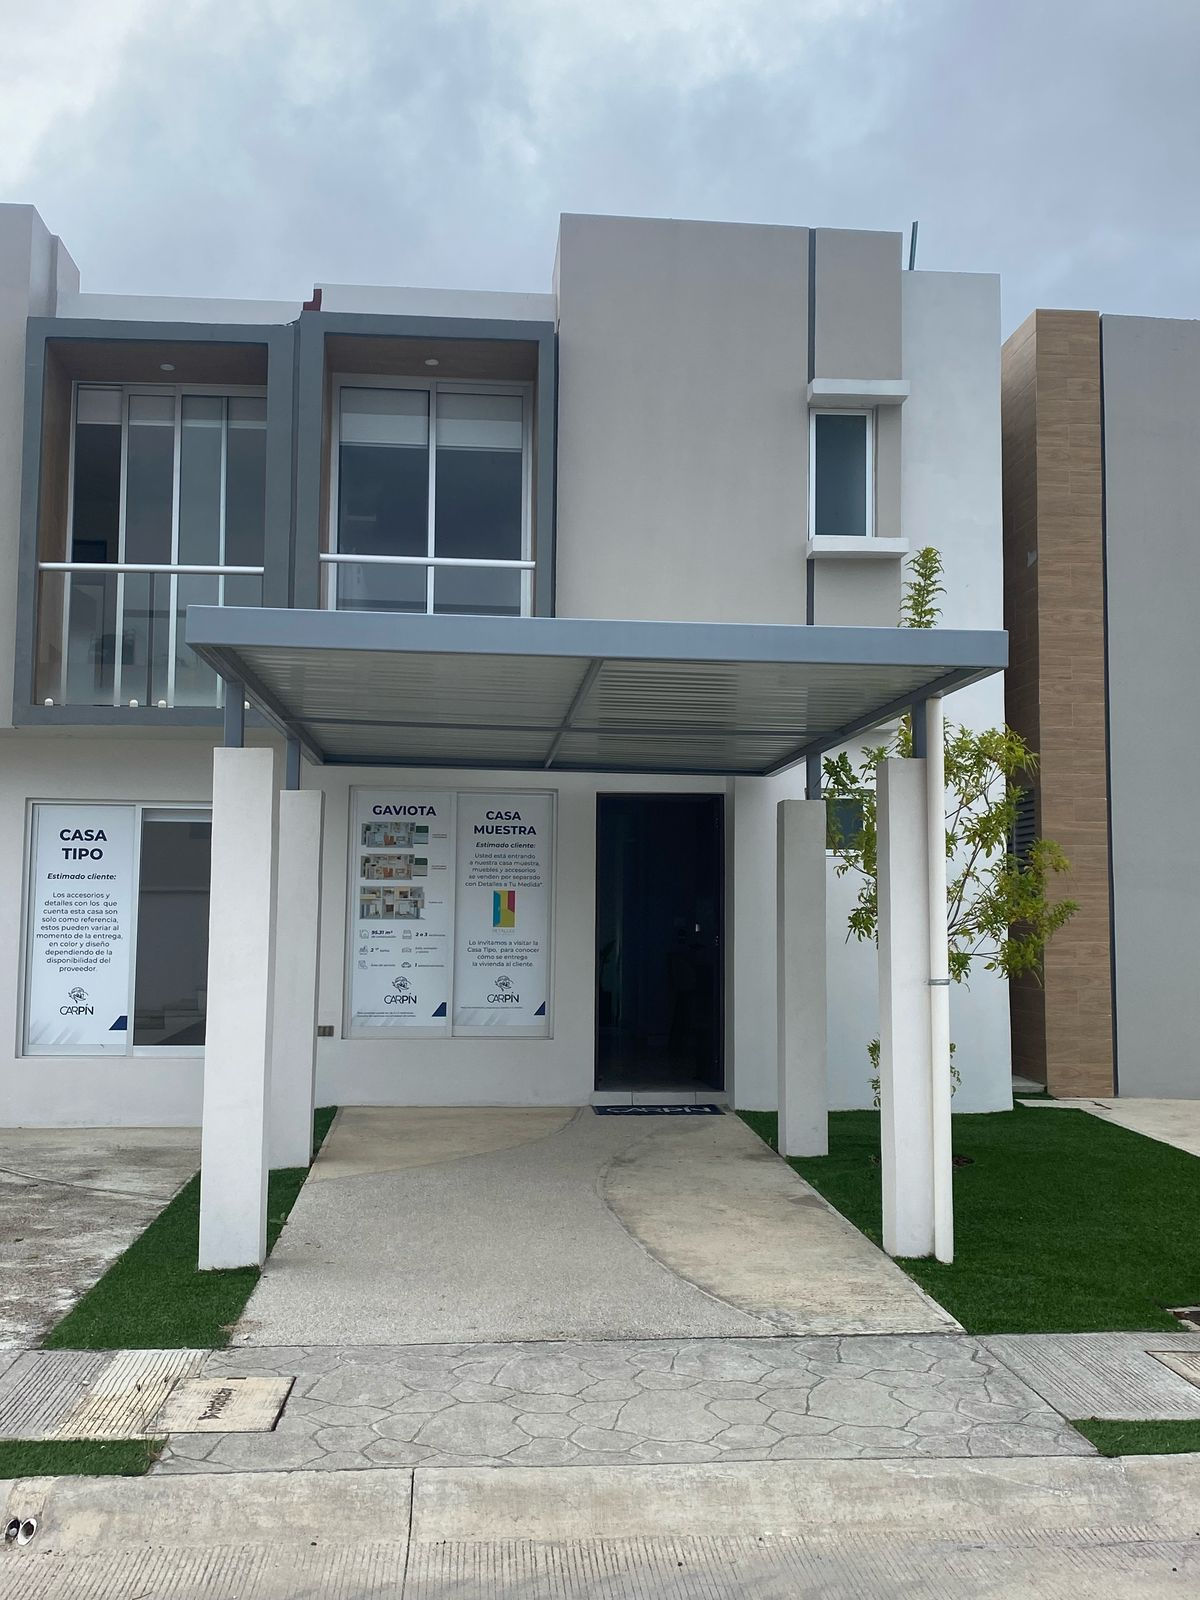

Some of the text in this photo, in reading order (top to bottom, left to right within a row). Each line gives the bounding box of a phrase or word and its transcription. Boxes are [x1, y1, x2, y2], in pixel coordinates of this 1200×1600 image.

[372, 805, 436, 816] GAVIOTA
[486, 811, 521, 820] CASA
[60, 829, 107, 841] CASA
[474, 825, 536, 835] MUESTRA
[62, 848, 103, 860] TIPO
